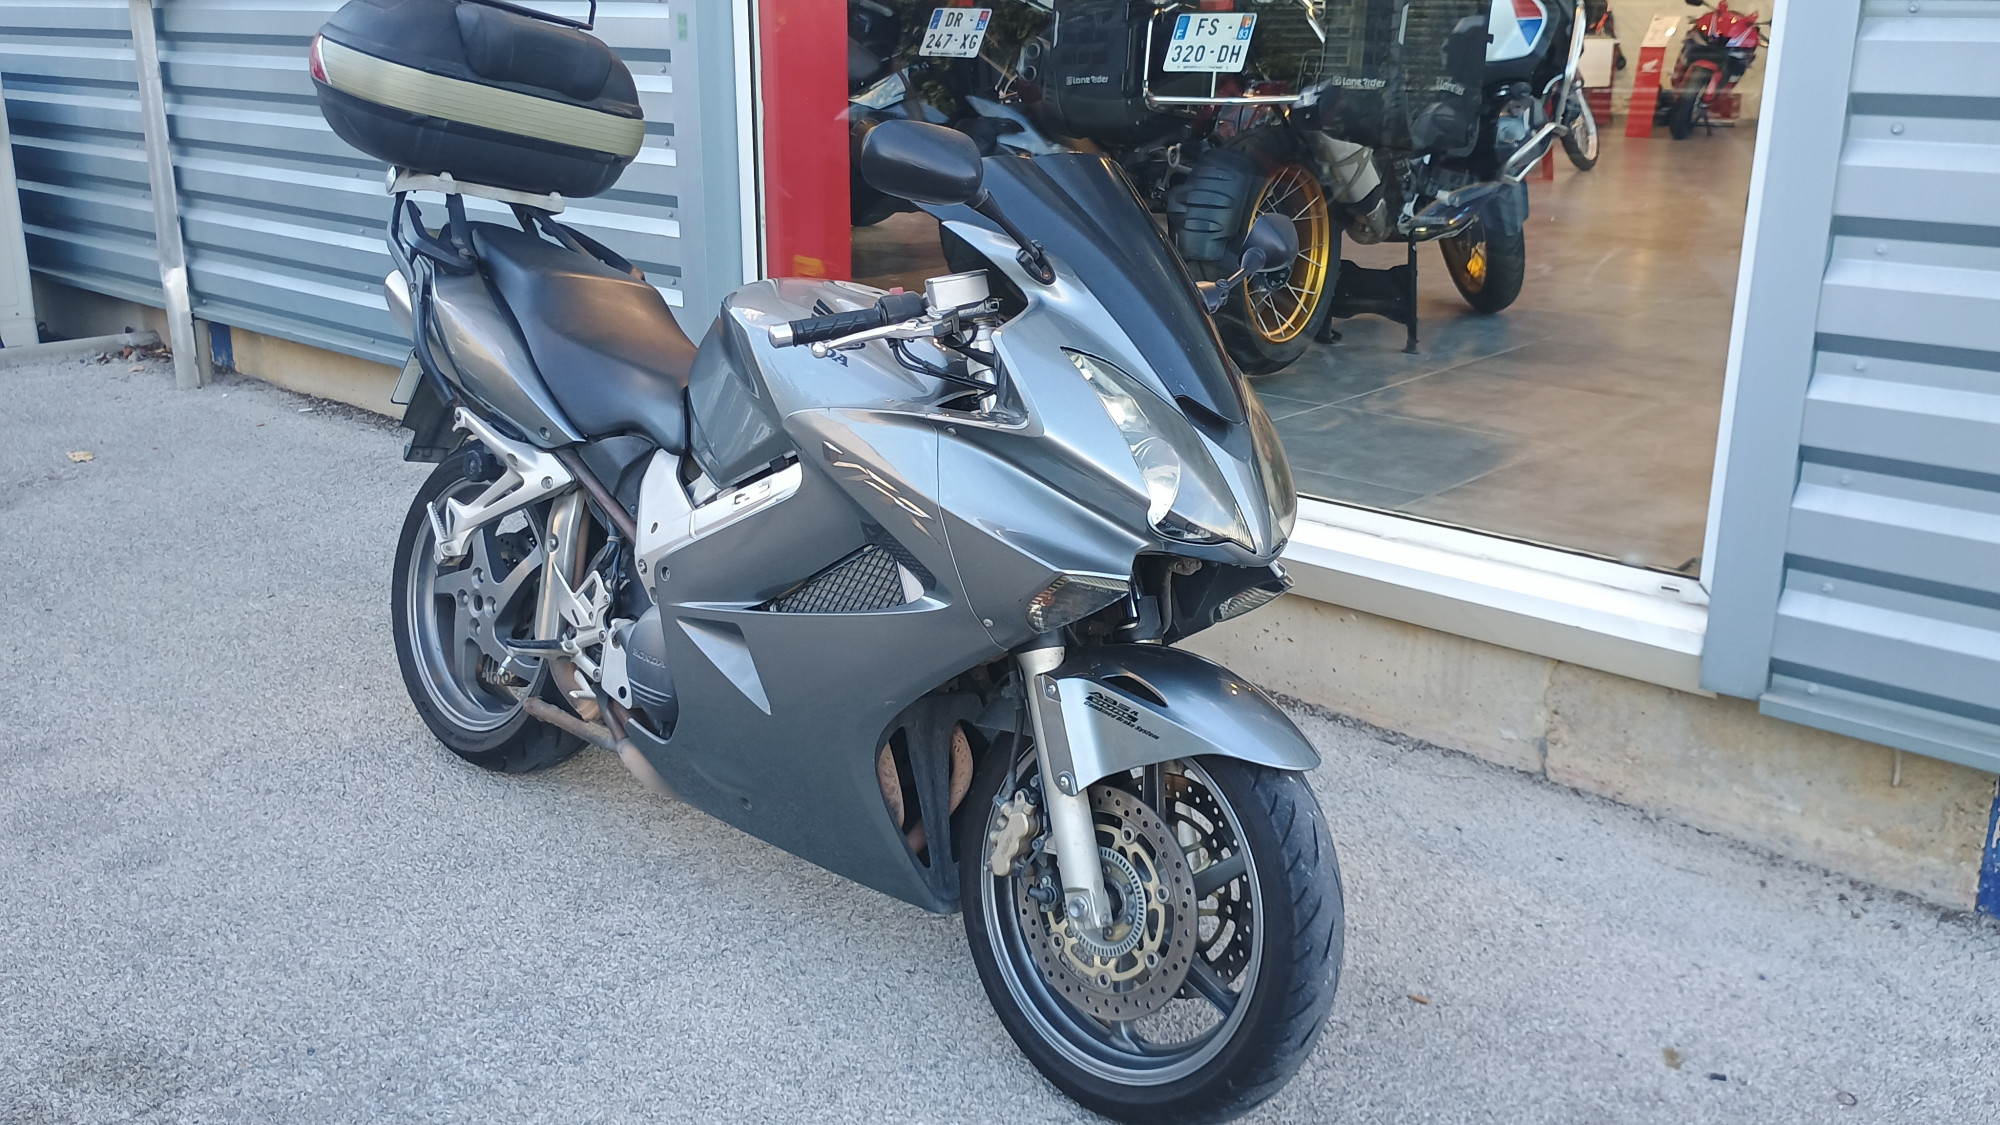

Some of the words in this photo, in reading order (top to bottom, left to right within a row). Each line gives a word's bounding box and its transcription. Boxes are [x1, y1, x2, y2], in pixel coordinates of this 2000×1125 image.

[945, 12, 963, 27] DR
[1195, 18, 1220, 36] FS
[926, 33, 979, 49] 247-XG
[1175, 29, 1184, 40] F
[1238, 29, 1249, 39] 83
[1171, 45, 1242, 63] 320-DH
[1342, 77, 1361, 86] Lone
[1083, 700, 1118, 719] Combined
[1115, 716, 1136, 729] Brake
[1135, 725, 1161, 741] System
